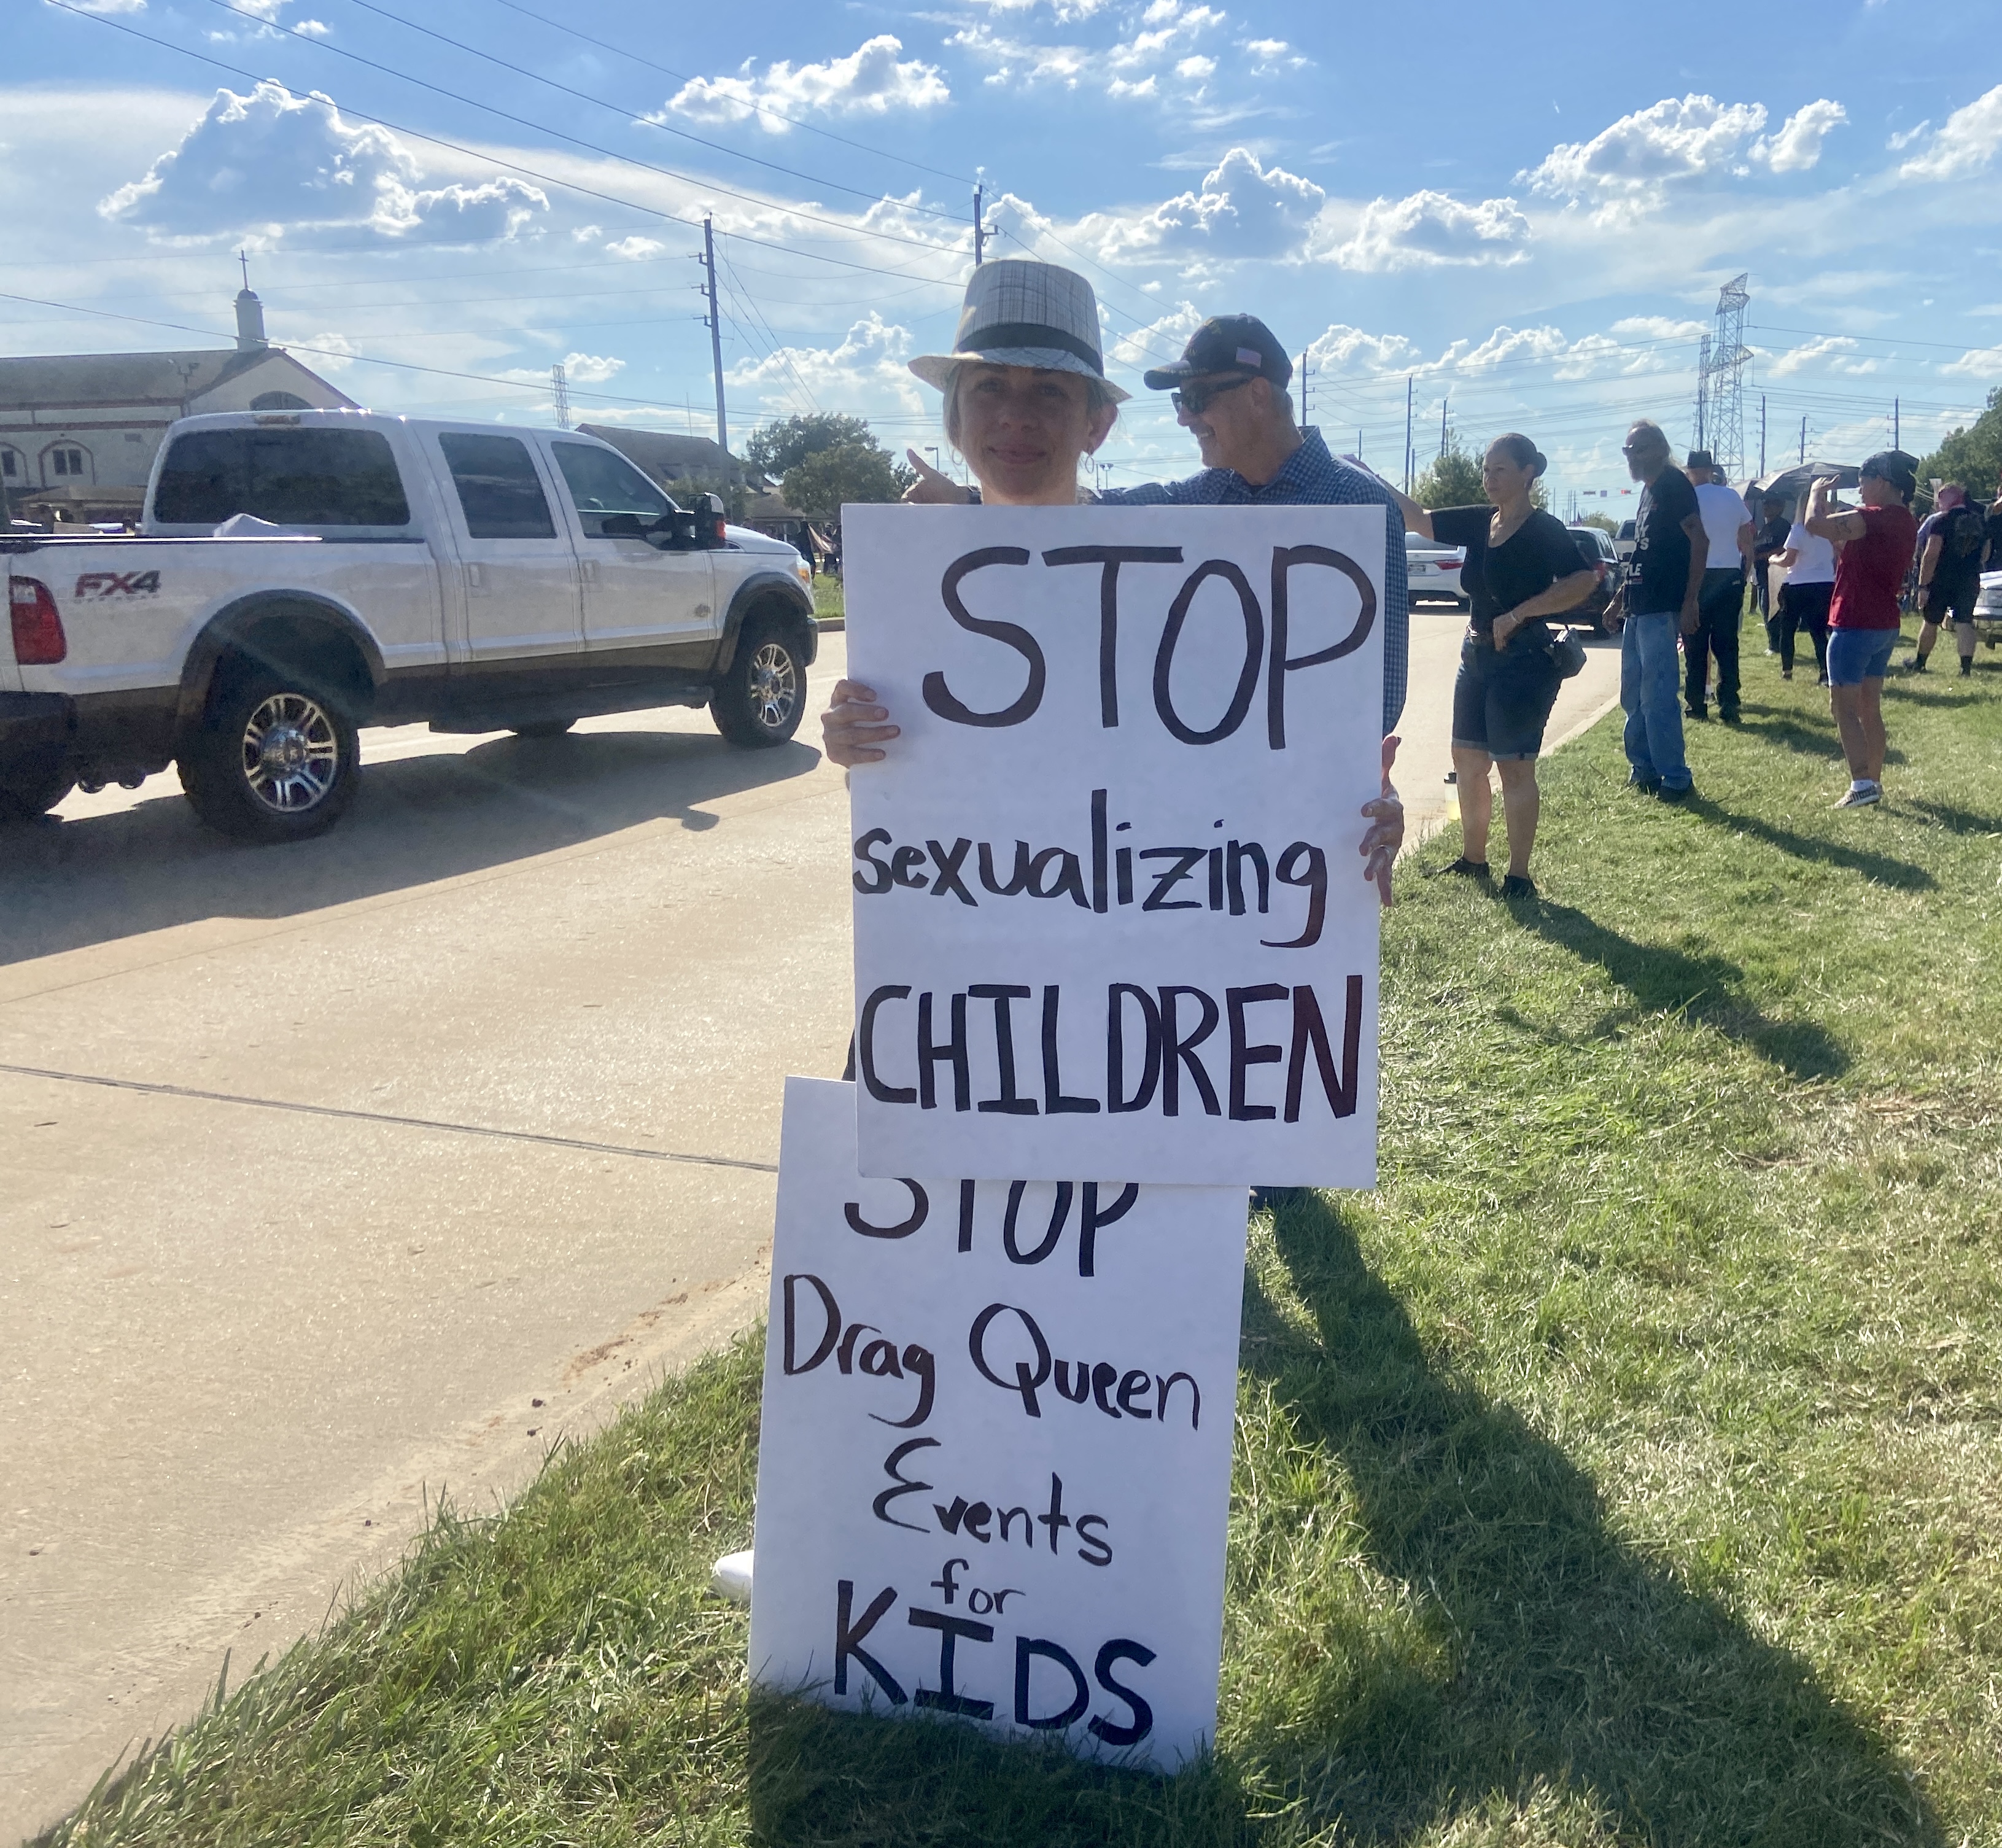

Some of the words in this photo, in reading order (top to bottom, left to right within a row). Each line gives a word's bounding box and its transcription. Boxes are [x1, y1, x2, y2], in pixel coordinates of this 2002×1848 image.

[75, 570, 161, 597] FX4
[923, 545, 1376, 750] STOP
[853, 789, 1327, 948] sexualizing
[859, 975, 1362, 1123] CHILDREN
[783, 1274, 936, 1428] Drag
[969, 1303, 1200, 1431] Queen
[872, 1437, 1112, 1566] Events
[930, 1558, 1026, 1614] for
[834, 1580, 1157, 1746] KIDS
